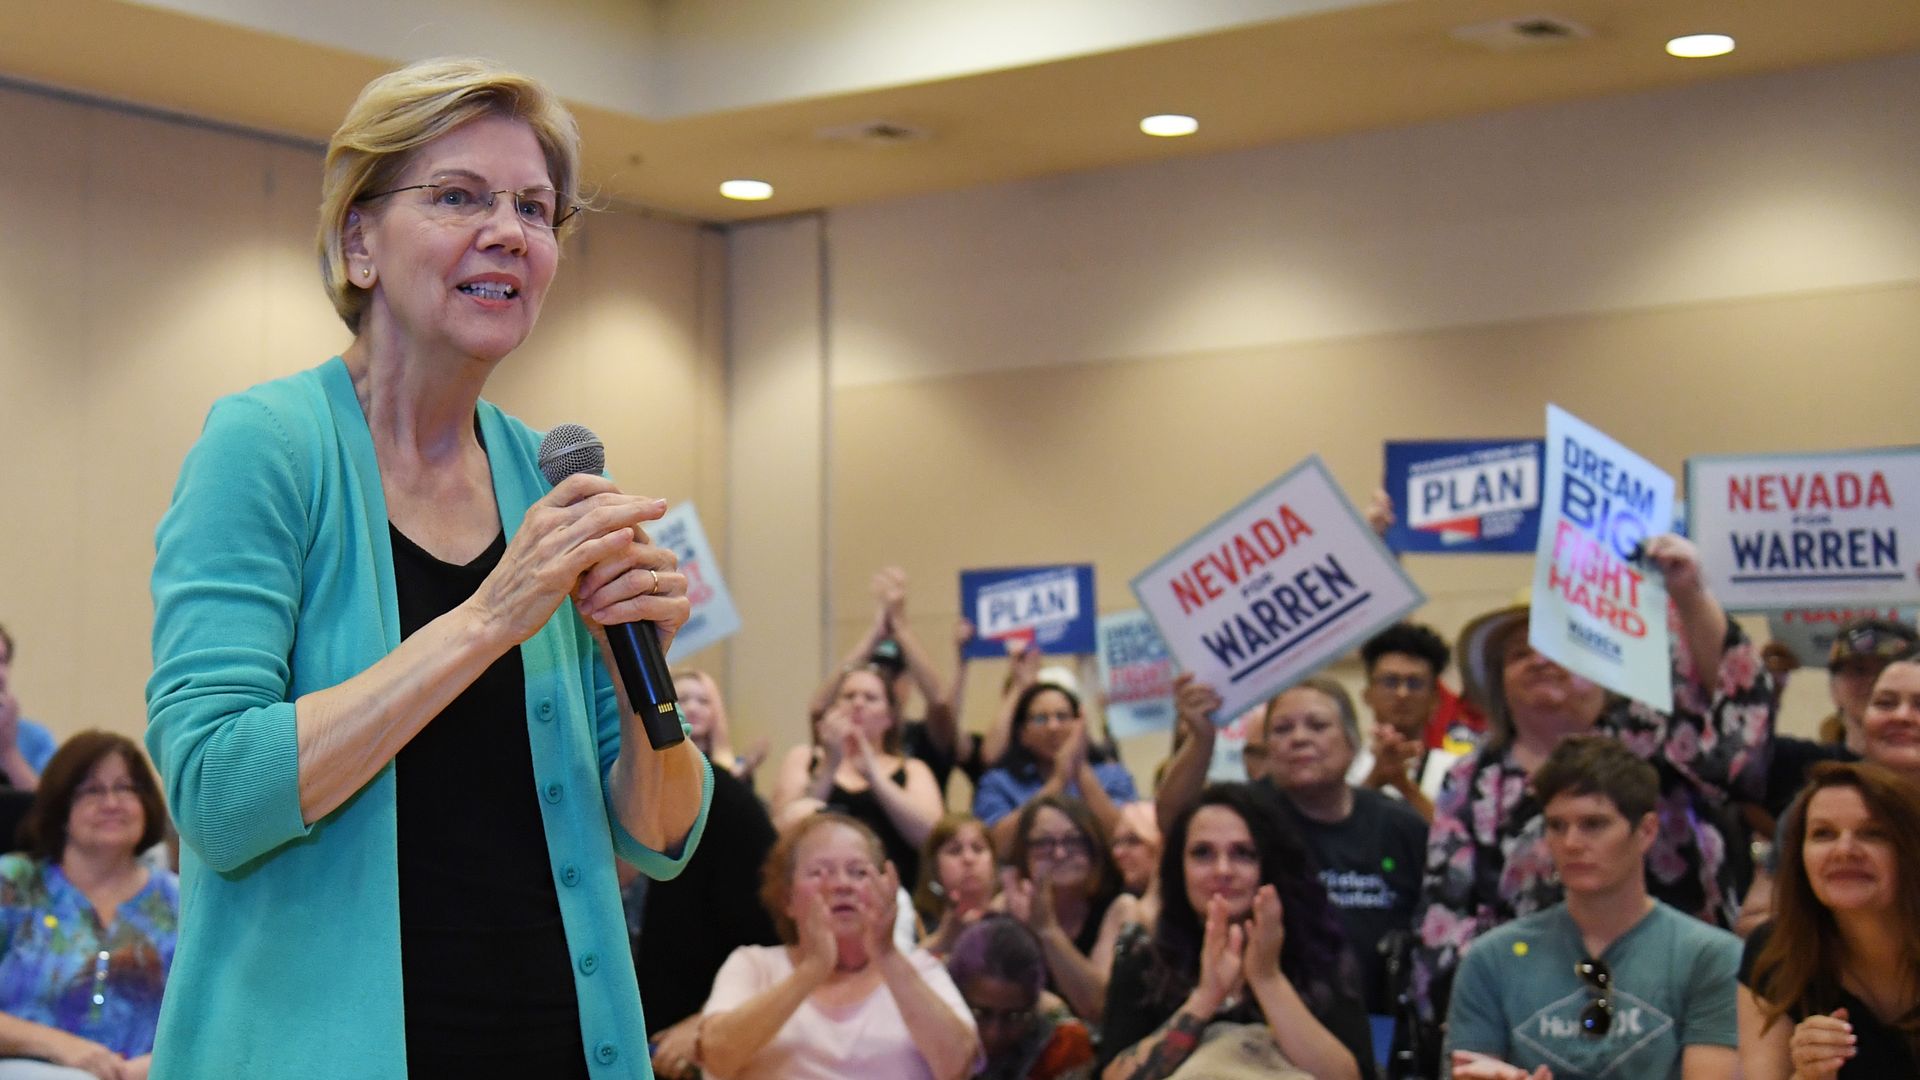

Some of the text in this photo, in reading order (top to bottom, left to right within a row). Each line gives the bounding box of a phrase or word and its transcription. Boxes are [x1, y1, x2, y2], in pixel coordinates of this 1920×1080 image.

[1422, 469, 1523, 516] PLAN
[1561, 471, 1648, 562] BIG
[1563, 433, 1655, 519] DREAM
[1728, 470, 1894, 512] NEVADA
[1170, 503, 1313, 615] NEVADA
[1552, 518, 1645, 609] FIGHT
[1730, 526, 1898, 569] WARREN
[989, 587, 1067, 628] PLAN
[1201, 552, 1357, 668] WARREN
[1547, 562, 1648, 640] HARD
